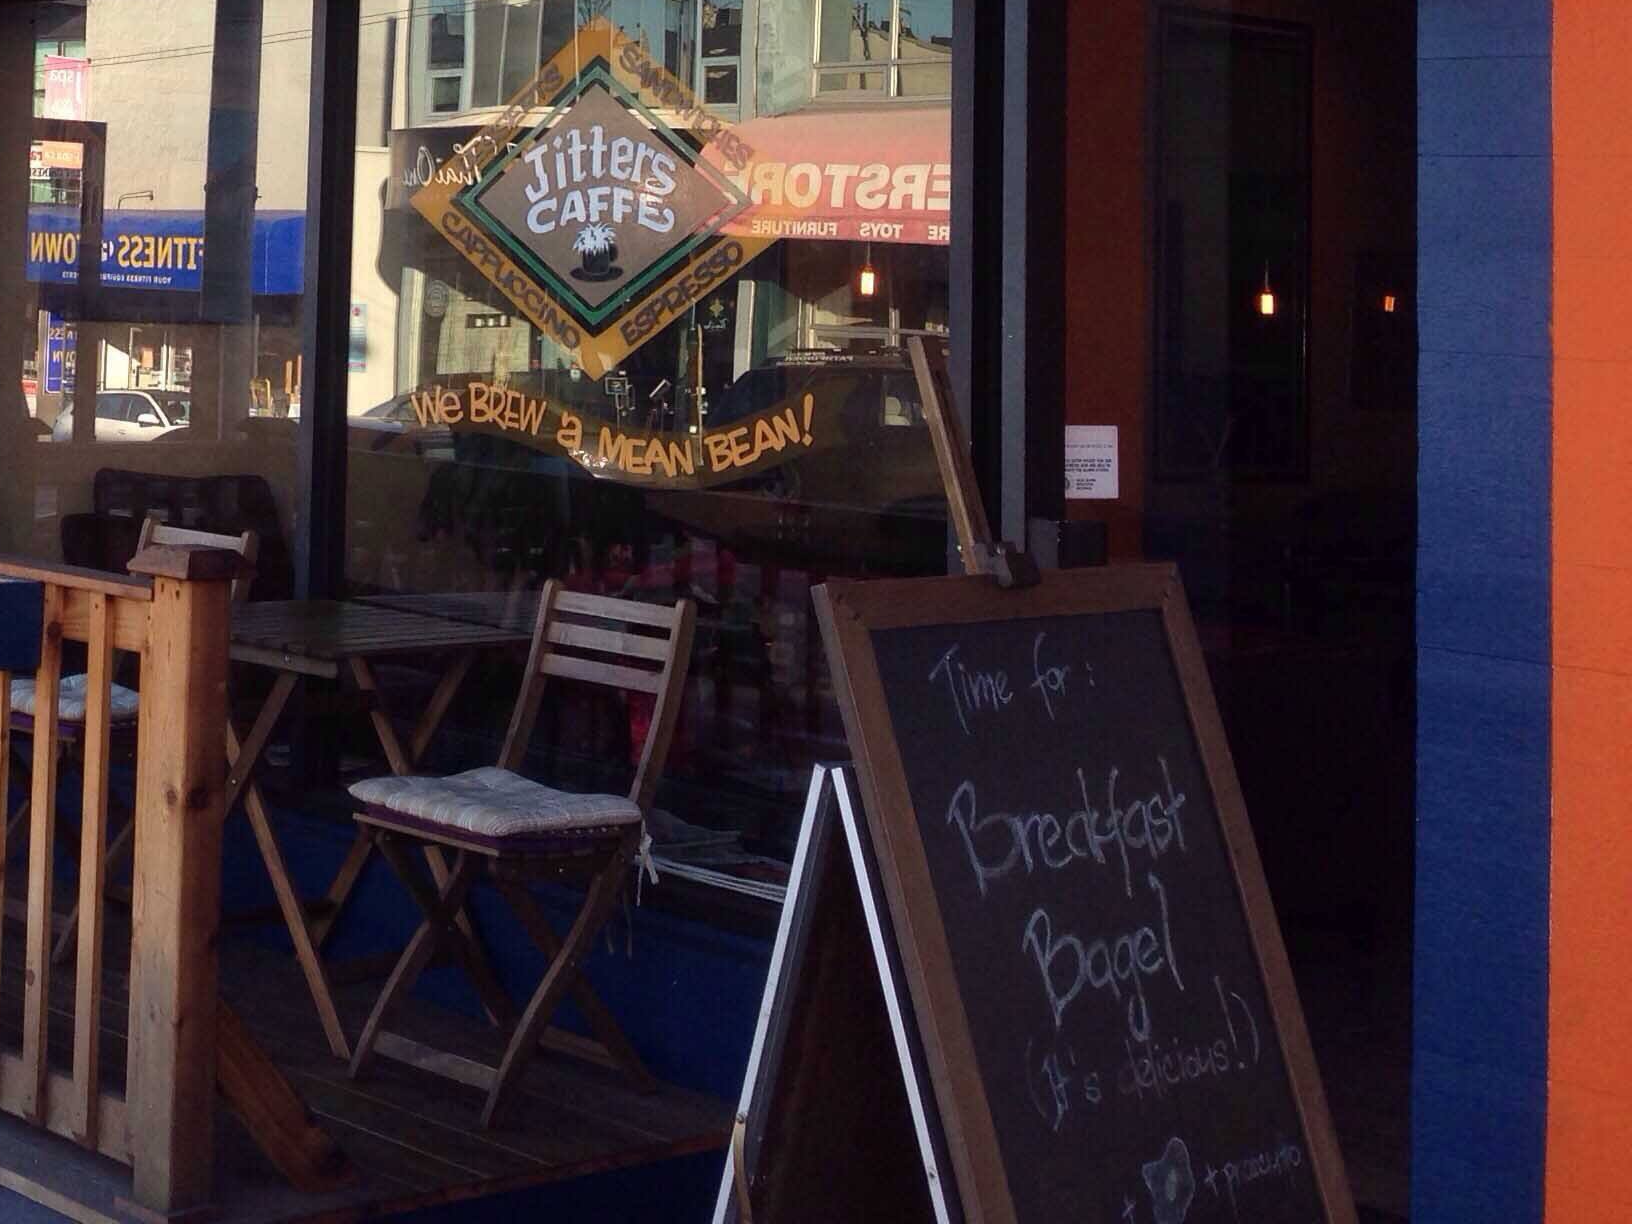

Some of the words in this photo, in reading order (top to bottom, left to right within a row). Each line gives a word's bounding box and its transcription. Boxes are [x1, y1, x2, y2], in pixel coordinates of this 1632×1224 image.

[524, 124, 677, 206] Jitters
[527, 185, 676, 234] CAFFE
[440, 211, 581, 350] CAPPUCCINO
[619, 240, 745, 347] ESPRESSO
[411, 388, 465, 430] We
[469, 381, 547, 437] BREW
[556, 414, 585, 453] a
[597, 430, 696, 478] MEAN
[704, 392, 817, 476] BEAN!
[929, 643, 1014, 735] Time
[946, 755, 1187, 900] Breakfast
[1022, 871, 1185, 1042] Bagel
